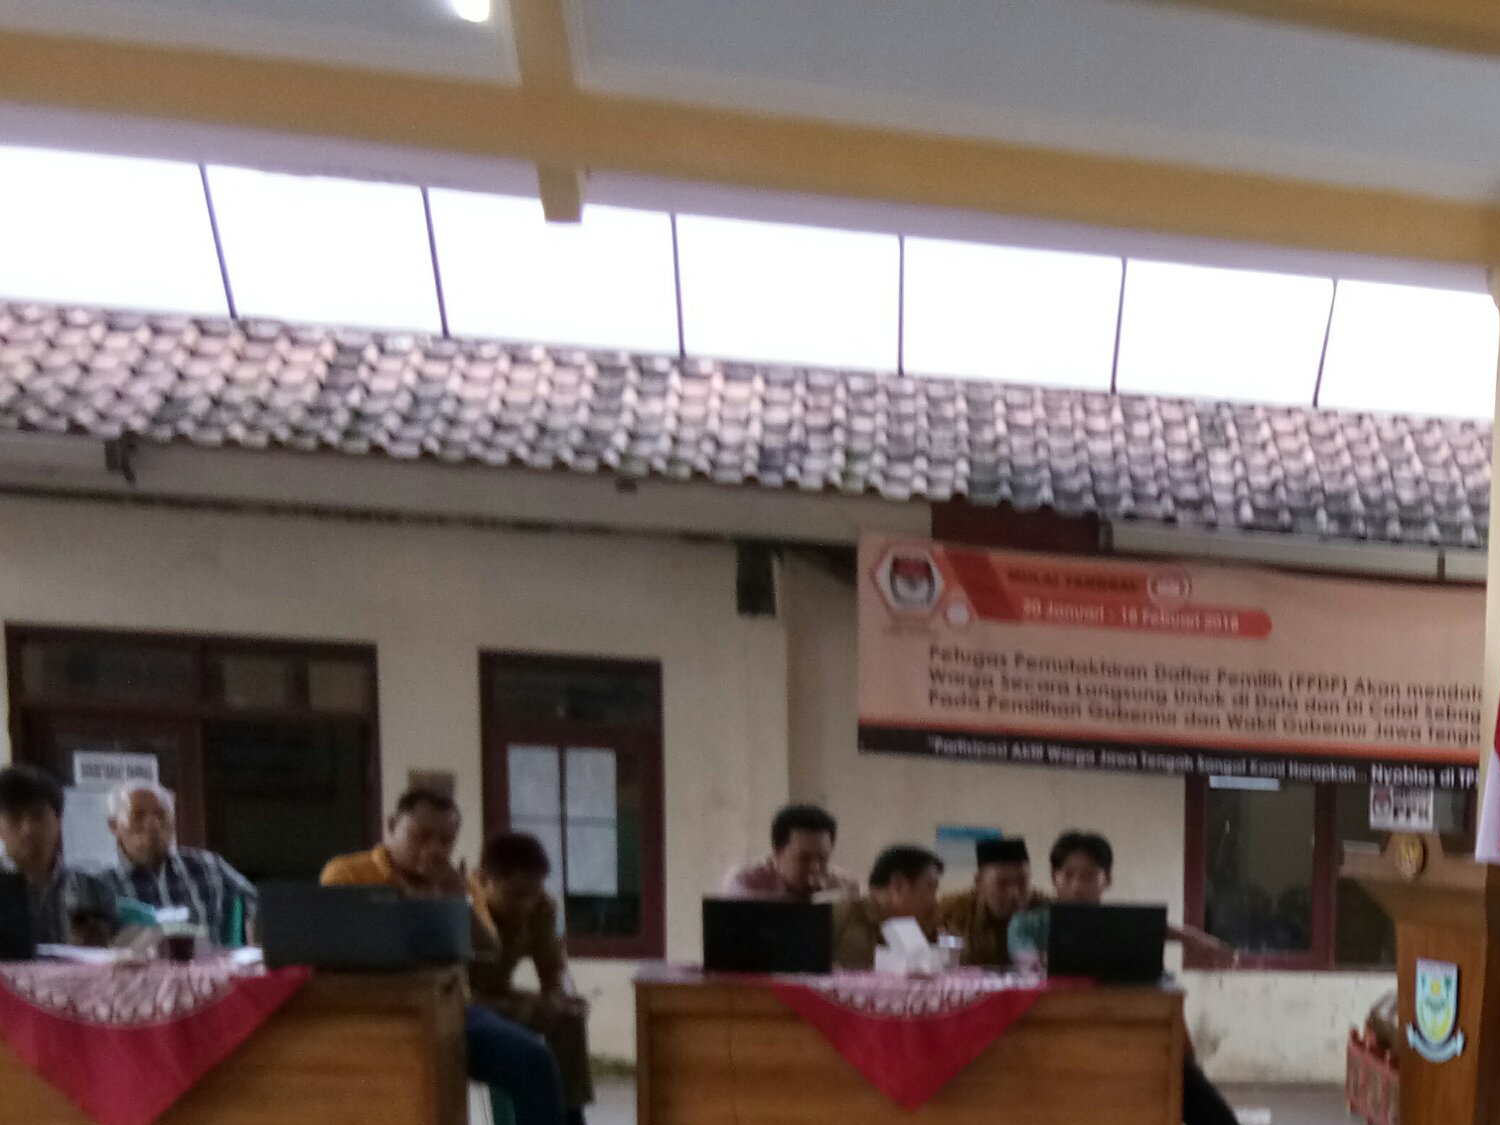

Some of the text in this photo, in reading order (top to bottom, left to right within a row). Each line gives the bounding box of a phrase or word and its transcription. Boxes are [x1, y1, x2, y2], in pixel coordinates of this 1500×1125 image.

[928, 643, 1008, 670] Petugas
[1216, 666, 1283, 690] Pemilih
[1353, 675, 1401, 698] Akan
[1405, 681, 1481, 702] mendat
[928, 666, 994, 690] Warga
[1001, 671, 1071, 696] Secara
[1075, 679, 1168, 707] Langsung
[1254, 691, 1300, 713] Data
[1304, 697, 1341, 714] dan
[1425, 702, 1481, 725] Sebag
[928, 687, 1481, 746] Pada Pemilihan Gubernur dan Wakil Gubernur Jawa Tenga
[1371, 763, 1436, 787] Nyoblos
[1440, 767, 1455, 788] di
